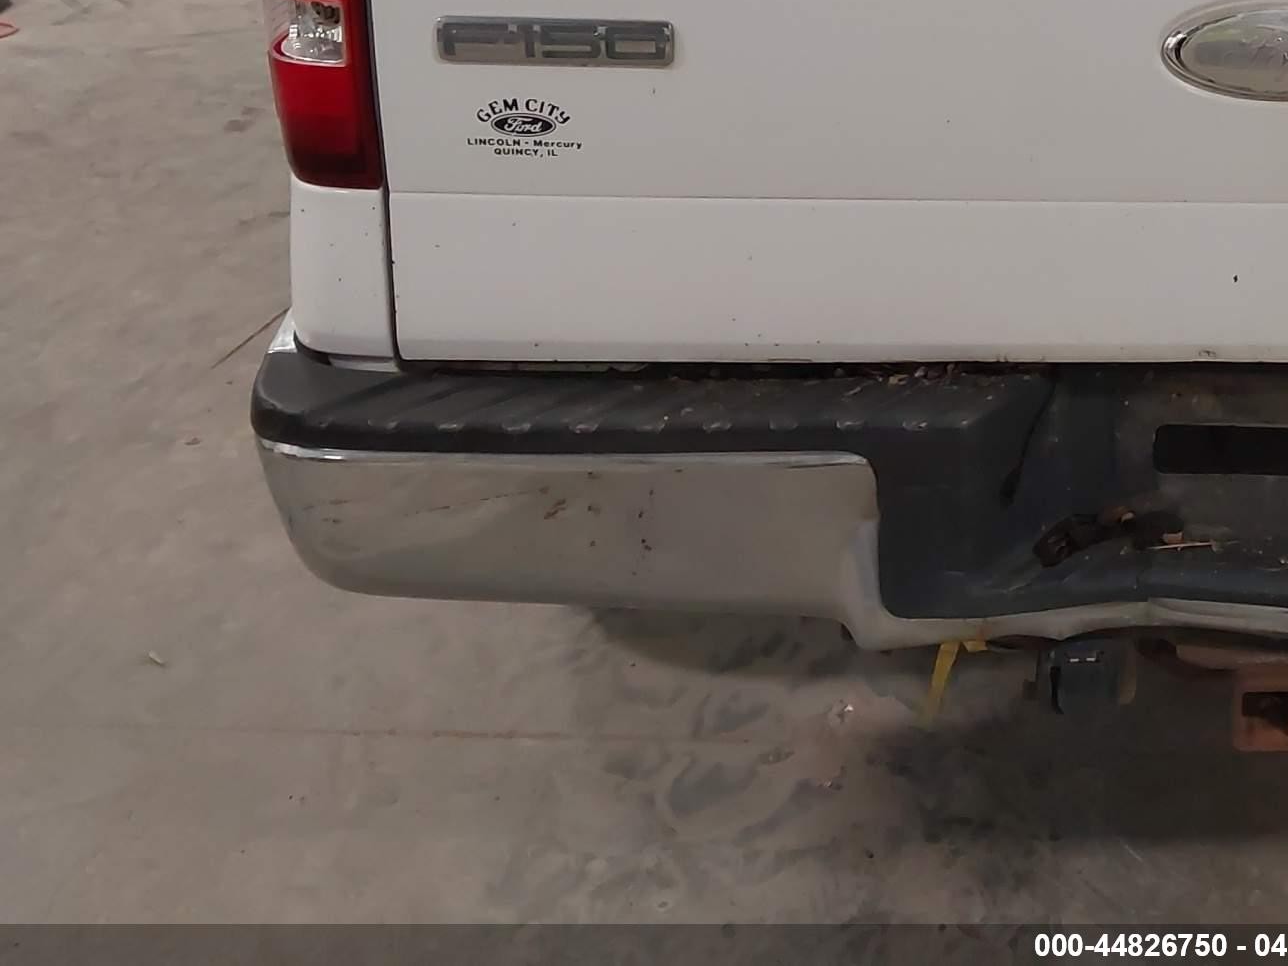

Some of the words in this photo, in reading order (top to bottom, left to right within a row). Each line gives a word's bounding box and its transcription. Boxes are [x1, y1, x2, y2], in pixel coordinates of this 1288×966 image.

[476, 98, 519, 123] GEM
[525, 98, 571, 125] CITY
[503, 117, 543, 133] Ford
[467, 138, 521, 147] LINCOLN
[533, 139, 582, 149] Mercury
[494, 147, 543, 158] QUINCY,
[547, 149, 559, 157] IL
